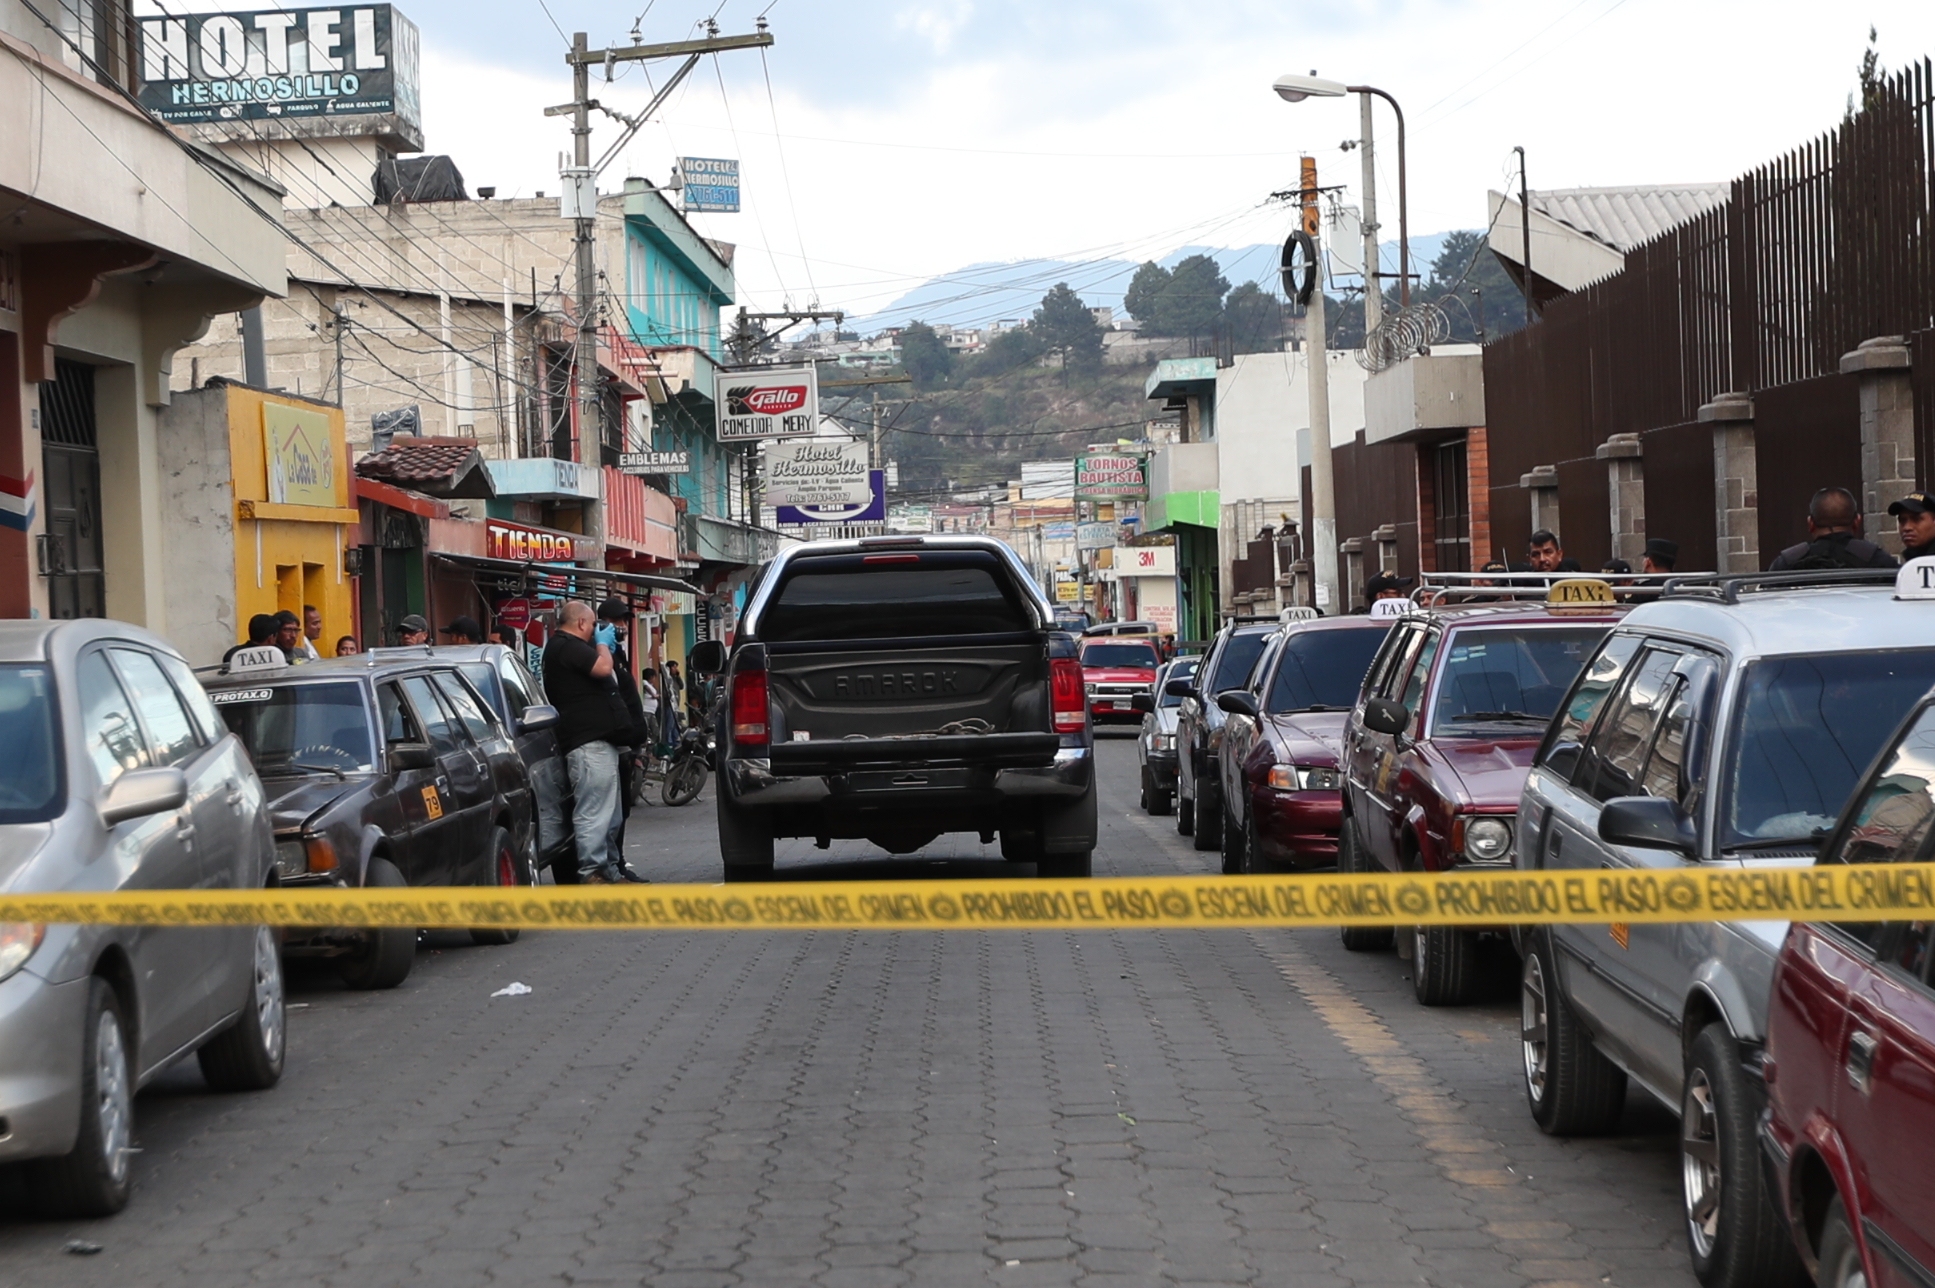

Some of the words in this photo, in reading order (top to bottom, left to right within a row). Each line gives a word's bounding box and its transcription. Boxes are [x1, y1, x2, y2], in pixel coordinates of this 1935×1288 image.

[142, 8, 386, 81] HOTEL
[172, 74, 360, 105] HERMOSILLO
[685, 160, 727, 173] HOTEL
[685, 172, 738, 186] HERMOSILLO
[749, 390, 799, 410] Gallo
[722, 416, 773, 436] COMEDOR
[782, 415, 812, 432] MERY
[620, 452, 687, 466] EMBLEMAS
[795, 444, 842, 462] Hotel
[651, 466, 664, 474] PARA
[771, 458, 865, 478] Hermosillo
[1086, 458, 1137, 470] TORNOS
[1080, 472, 1143, 483] BAUTISTA
[807, 492, 851, 502] 7761-5117
[489, 525, 572, 560] TIENDA
[1138, 552, 1155, 566] 3M
[1286, 610, 1311, 620] TAXI
[238, 650, 274, 666] TAXI
[835, 671, 957, 696] AMAROK
[426, 795, 440, 813] 79
[551, 900, 651, 925] PROHIBIDO
[651, 901, 676, 924] EL
[675, 899, 727, 924] PASO
[755, 897, 820, 923] ESCENA
[822, 896, 856, 922] DEL
[858, 895, 925, 922] CRIMEN
[961, 891, 1071, 922] PROHIBIDO
[1071, 890, 1100, 920] EL
[1102, 889, 1159, 920] PASO
[1198, 886, 1276, 919] ESCENA
[1275, 885, 1313, 918] DEL
[1316, 883, 1395, 917] CRIMEN
[1436, 879, 1560, 916] PROHIBIDO
[1564, 878, 1597, 914] EL
[1599, 876, 1661, 914] PASO
[1707, 873, 1798, 912] ESCENA
[1798, 871, 1846, 910] DEL
[1846, 868, 1933, 909] CRIMEN
